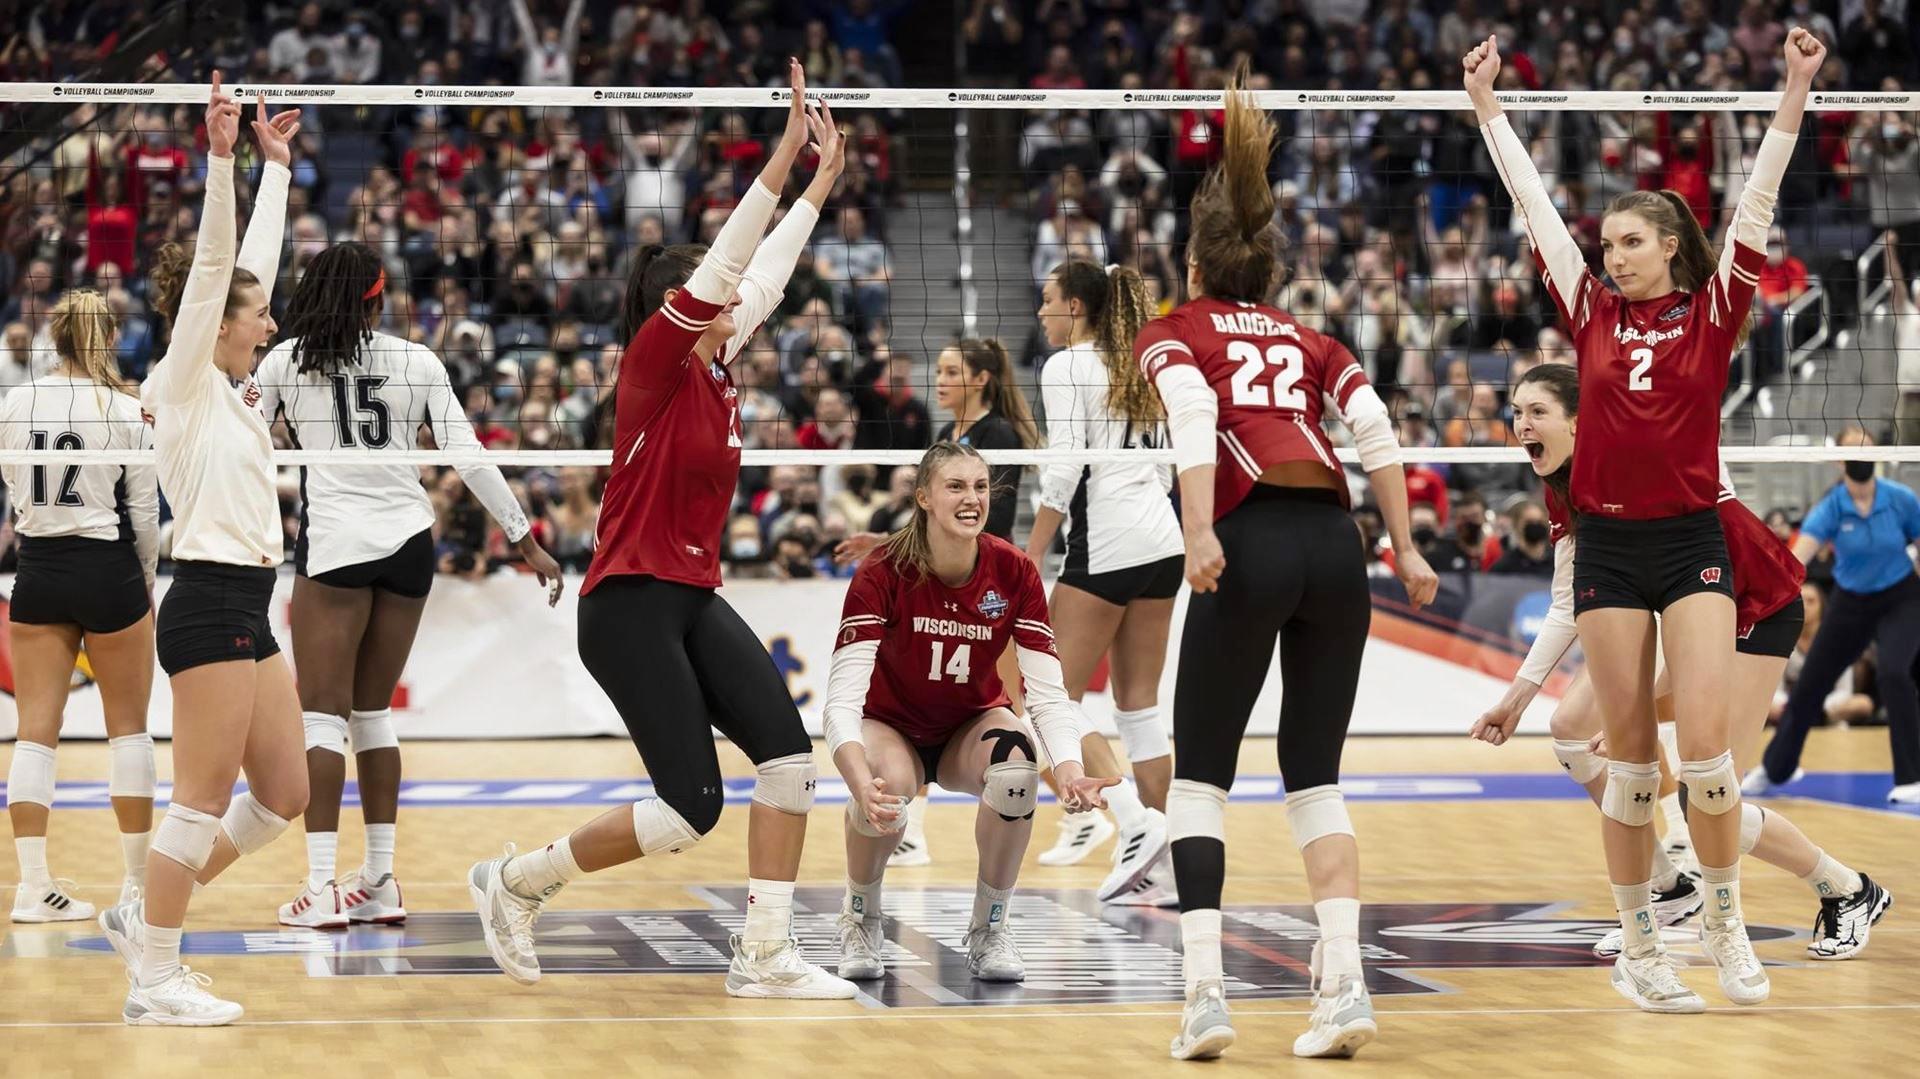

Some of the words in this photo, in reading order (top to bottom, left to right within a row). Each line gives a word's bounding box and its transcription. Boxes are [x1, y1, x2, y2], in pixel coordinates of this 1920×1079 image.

[63, 87, 102, 95] VOLLEYBALL
[104, 88, 154, 96] CHAMPIONSHIP
[285, 90, 336, 98] CHAMPIONSHIP
[425, 89, 463, 98] VOLLEYBALL
[464, 90, 514, 98] CHAMPIONSHIP
[604, 91, 642, 99] VOLLEYBALL
[643, 92, 694, 100] CHAMPIONSHIP
[821, 92, 870, 100] CHAMPIONSHIP
[958, 93, 996, 101] VOLLEYBALL
[997, 94, 1046, 102] CHAMPIONSHIP
[1133, 94, 1171, 102] VOLLEYBALL
[1172, 94, 1222, 102] CHAMPIONSHIP
[1308, 94, 1346, 102] VOLLEYBALL
[1346, 94, 1396, 102] CHAMPIONSHIP
[1519, 94, 1568, 104] CHAMPIONSHIP
[1653, 95, 1690, 103] VOLLEYBALL
[1690, 96, 1738, 104] CHAMPIONSHIP
[1824, 95, 1861, 103] VOLLEYBALL
[1861, 96, 1910, 104] CHAMPIONSHIP
[1628, 347, 1653, 391] 2
[1226, 340, 1307, 411] 22
[326, 373, 392, 449] 15
[29, 430, 84, 506] 12
[913, 616, 993, 641] WISCONSIN
[928, 640, 971, 684] 14
